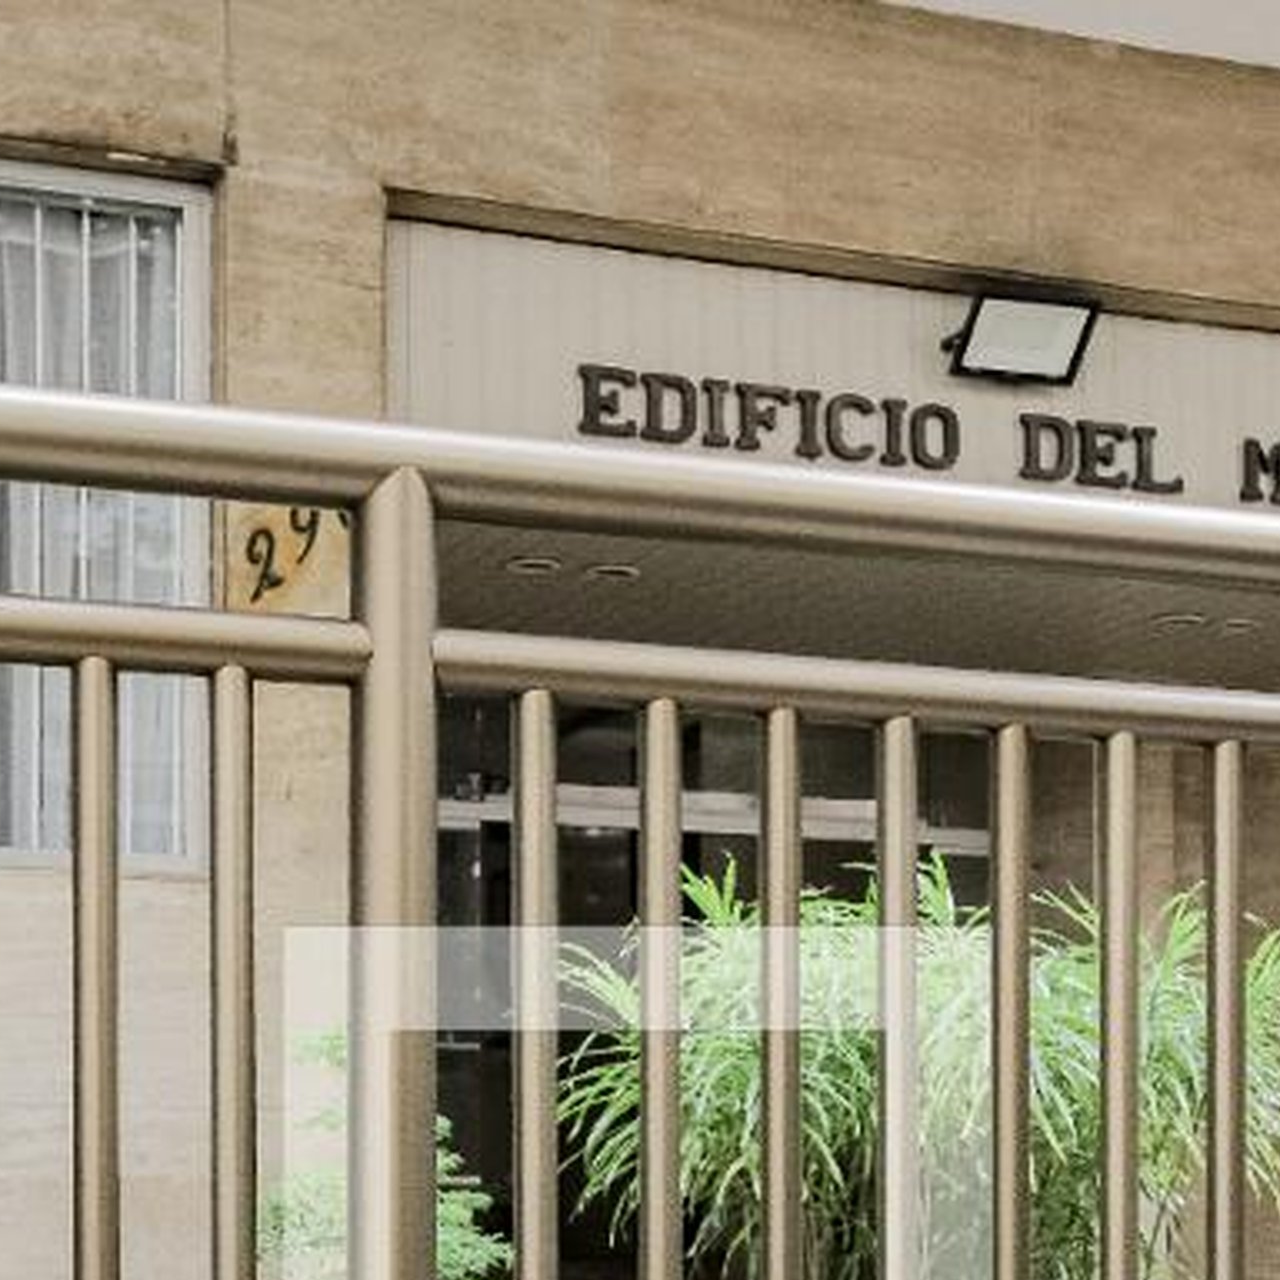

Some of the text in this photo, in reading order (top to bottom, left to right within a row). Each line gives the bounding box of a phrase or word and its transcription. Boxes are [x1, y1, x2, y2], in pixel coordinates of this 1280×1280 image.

[577, 363, 961, 471] EDIFICIO
[1019, 413, 1184, 494] DEL
[246, 508, 349, 603] 29
